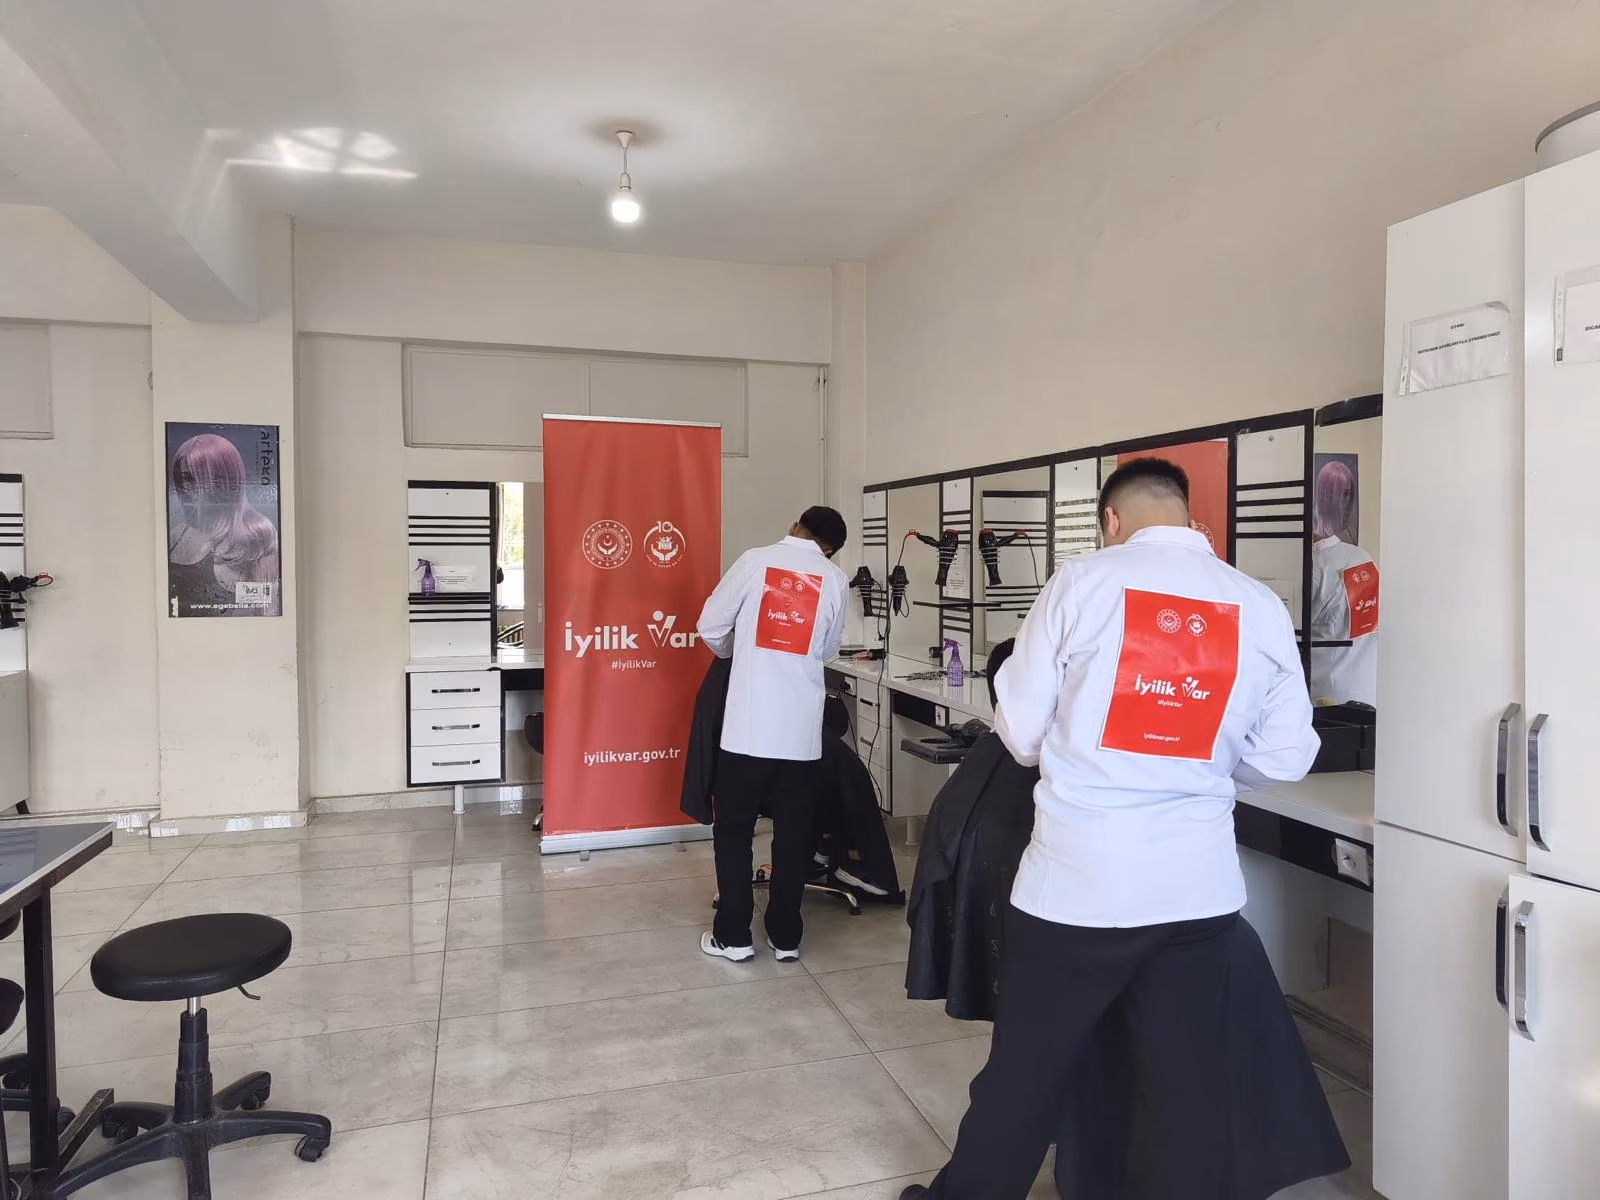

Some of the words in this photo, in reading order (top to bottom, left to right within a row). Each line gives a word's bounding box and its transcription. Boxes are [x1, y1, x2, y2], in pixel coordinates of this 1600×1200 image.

[564, 621, 640, 658] İyilik
[647, 610, 701, 648] Var
[1134, 673, 1177, 697] İyilik
[1181, 676, 1211, 700] Var
[583, 747, 681, 766] iyilikvar.gov.tr
